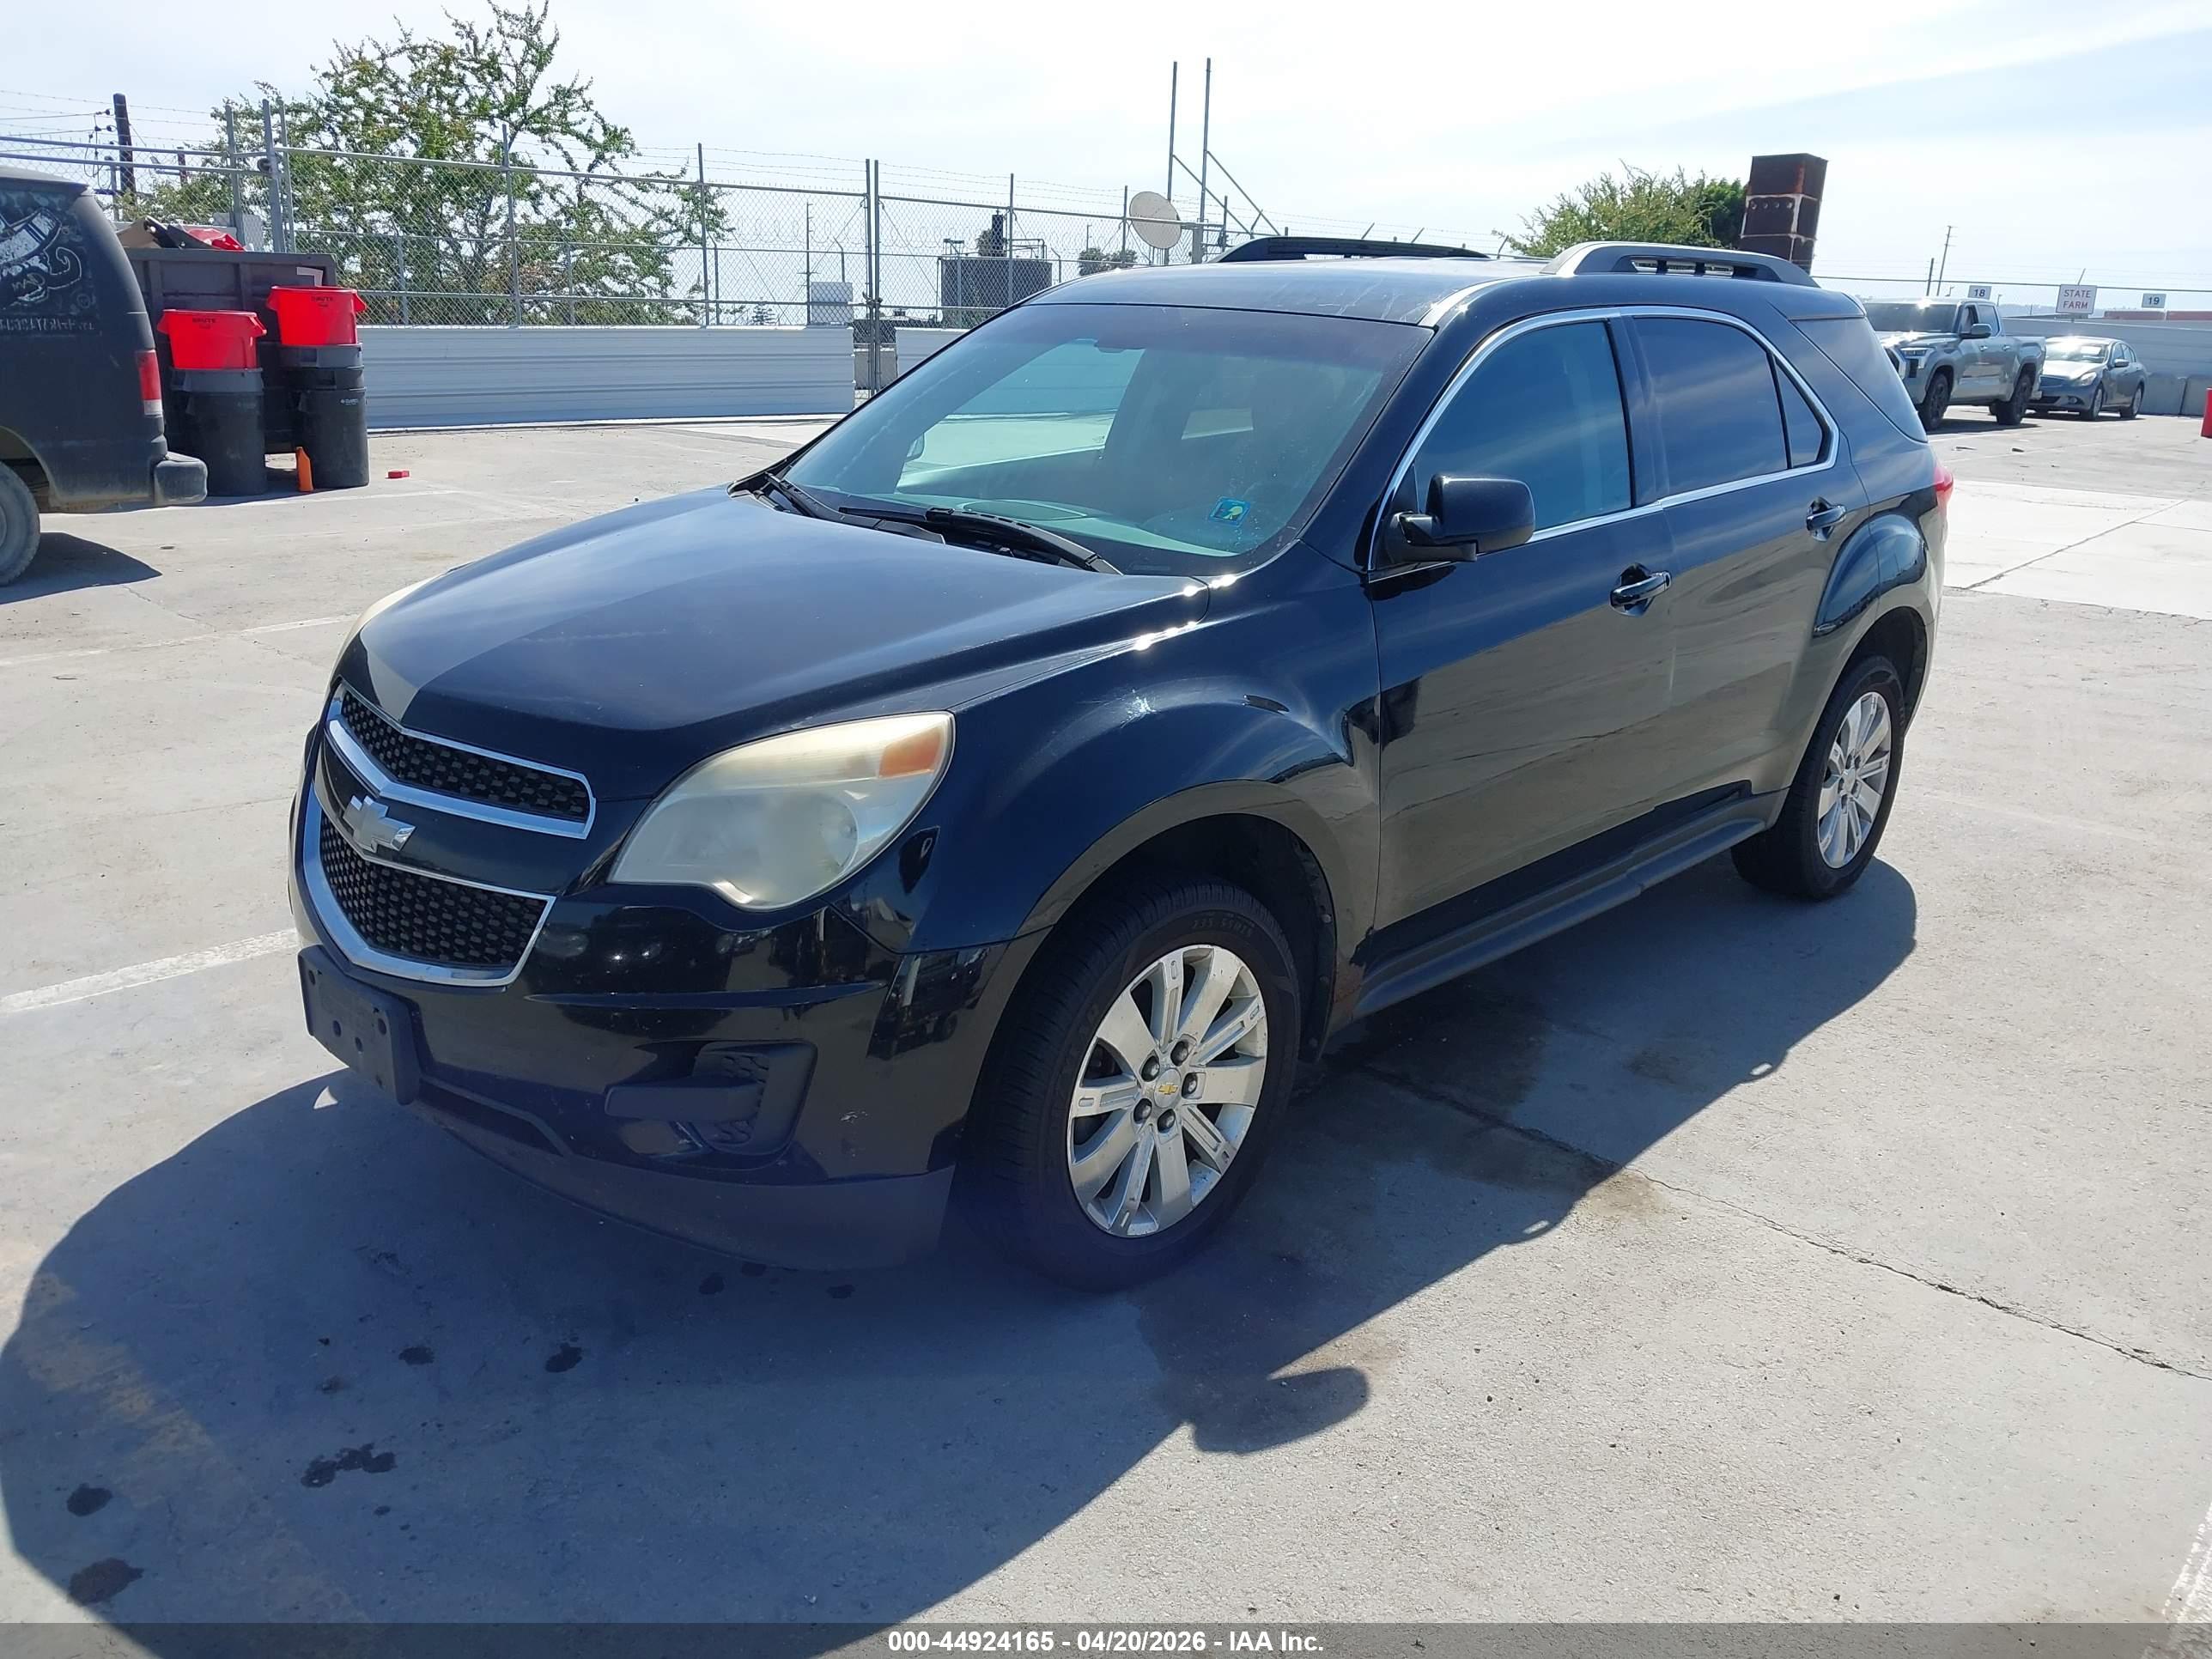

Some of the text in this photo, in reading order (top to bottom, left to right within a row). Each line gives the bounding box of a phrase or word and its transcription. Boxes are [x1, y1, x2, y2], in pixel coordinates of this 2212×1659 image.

[1974, 289, 1985, 297] 18
[2063, 289, 2092, 298] STATE
[2148, 296, 2160, 305] 19
[2063, 301, 2088, 309] FARM
